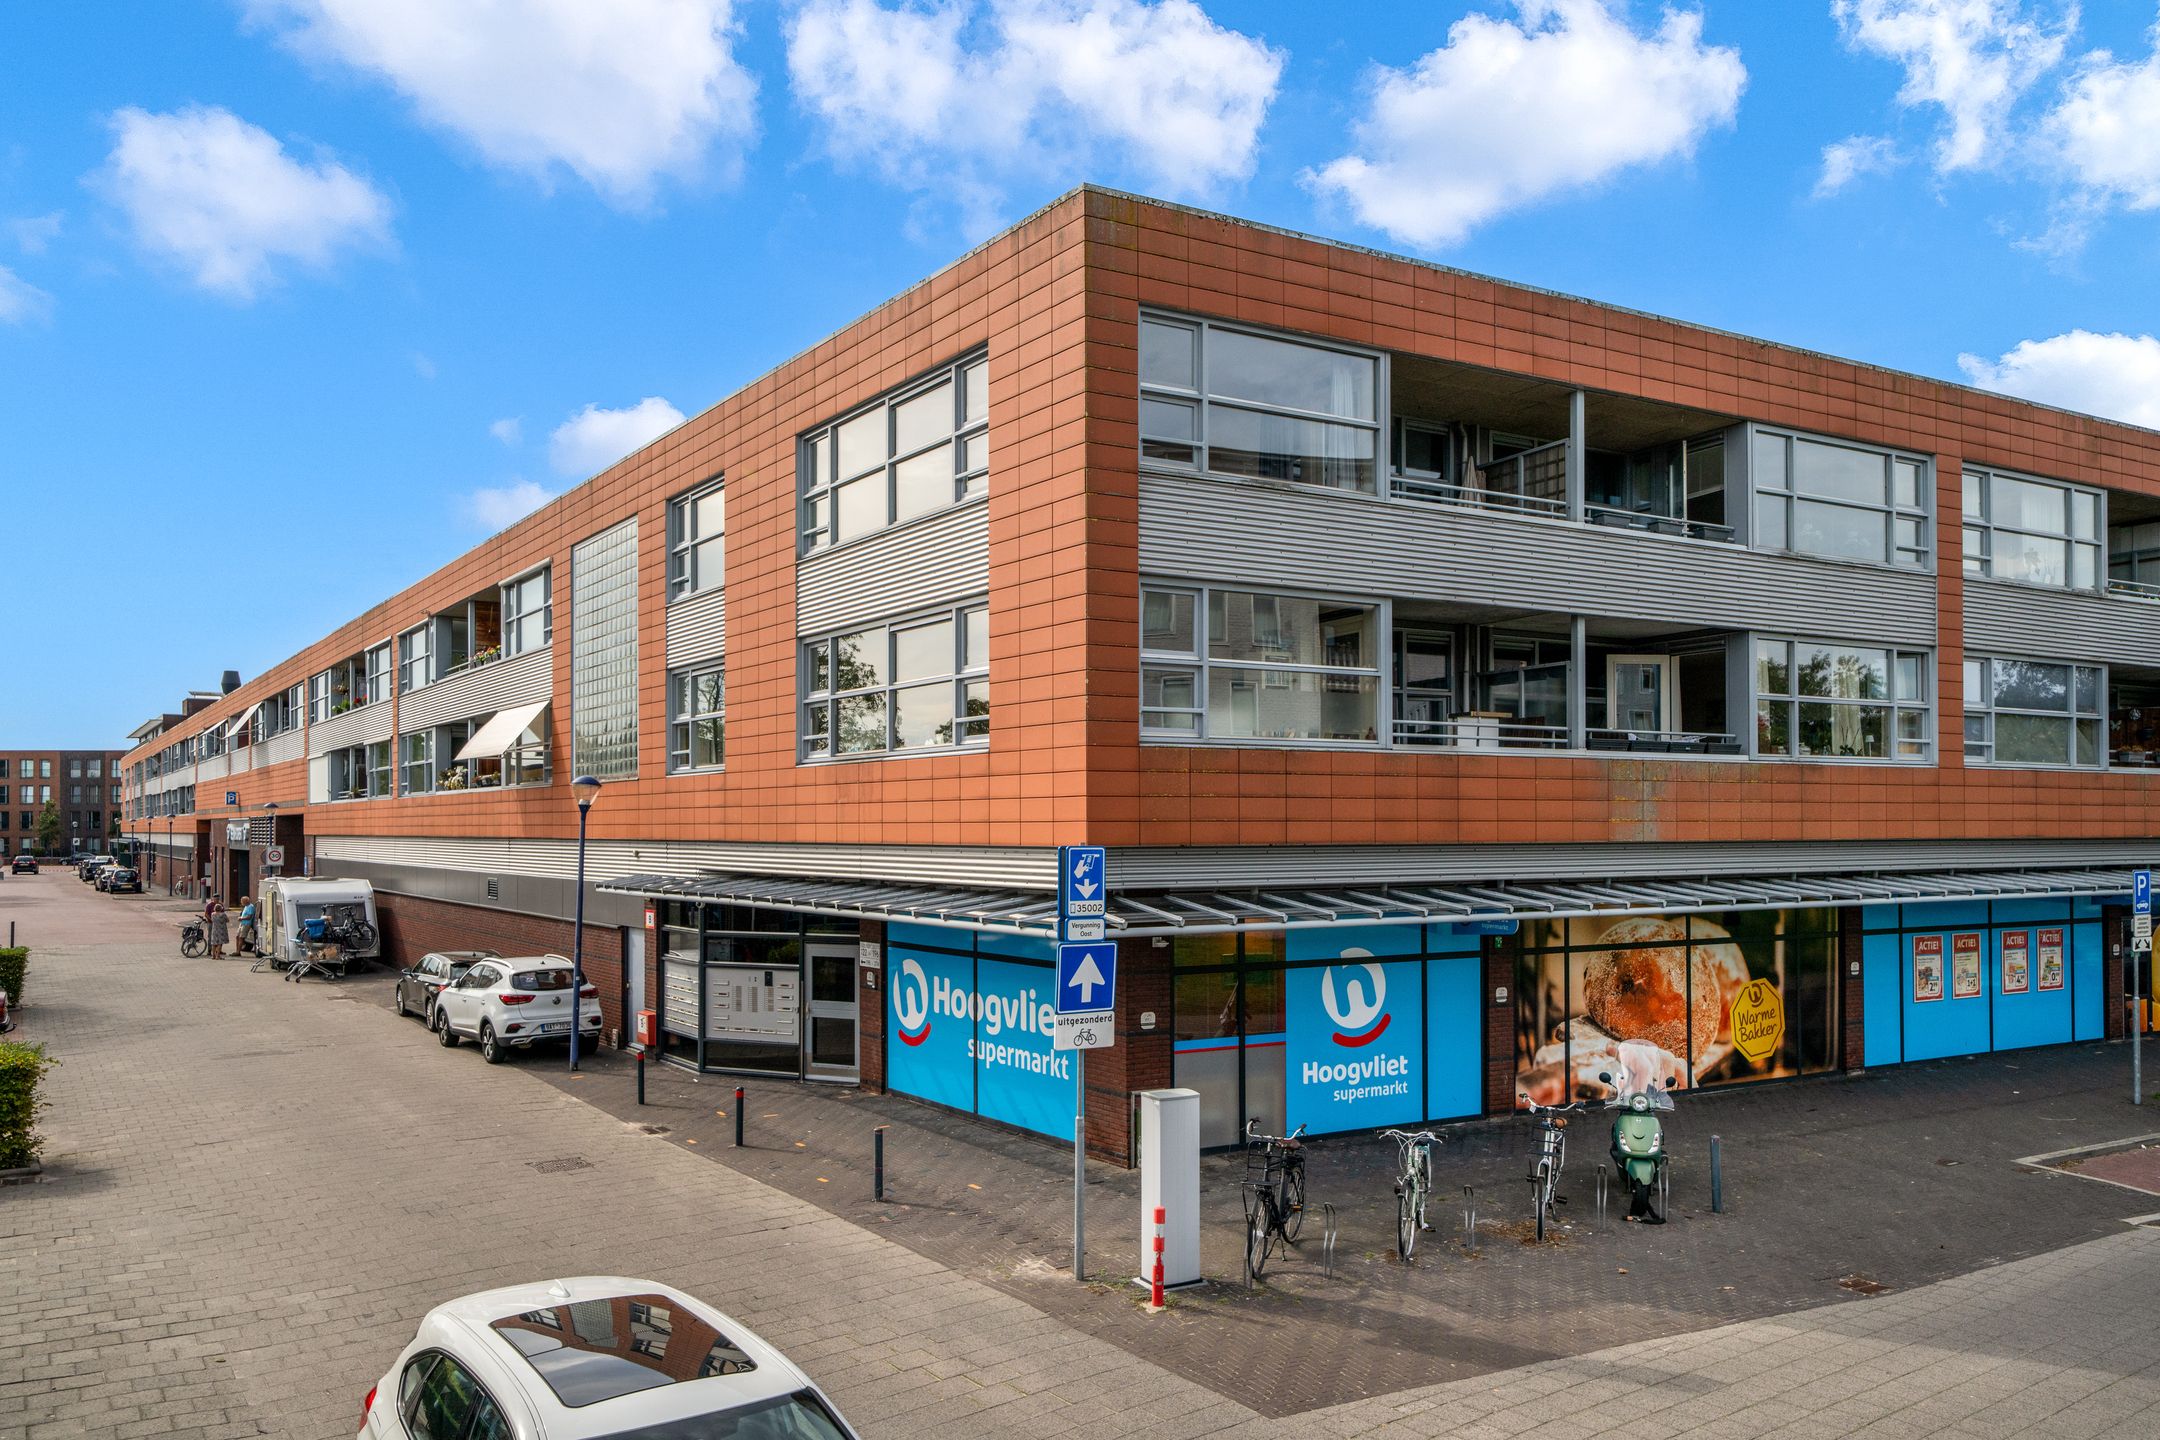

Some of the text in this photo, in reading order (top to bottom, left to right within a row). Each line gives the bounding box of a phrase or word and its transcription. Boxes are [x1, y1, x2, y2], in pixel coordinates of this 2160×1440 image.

[2138, 875, 2147, 896] P
[1077, 903, 1103, 913] 35002
[1071, 922, 1101, 930] Vergunning
[1918, 941, 1939, 951] ACTIE!
[1957, 938, 1976, 949] ACTIE!
[2006, 935, 2025, 945] ACTIE!
[2042, 933, 2060, 944] ACTIE!
[933, 975, 1056, 1037] Hoogvlie
[1057, 1014, 1113, 1027] uitgezonderd
[1738, 1007, 1777, 1026] Warme
[1738, 1021, 1777, 1042] Bakker
[967, 1038, 1069, 1081] supermarkt
[1303, 1053, 1409, 1085] Hoogvliet
[1333, 1080, 1408, 1104] supermarkt
